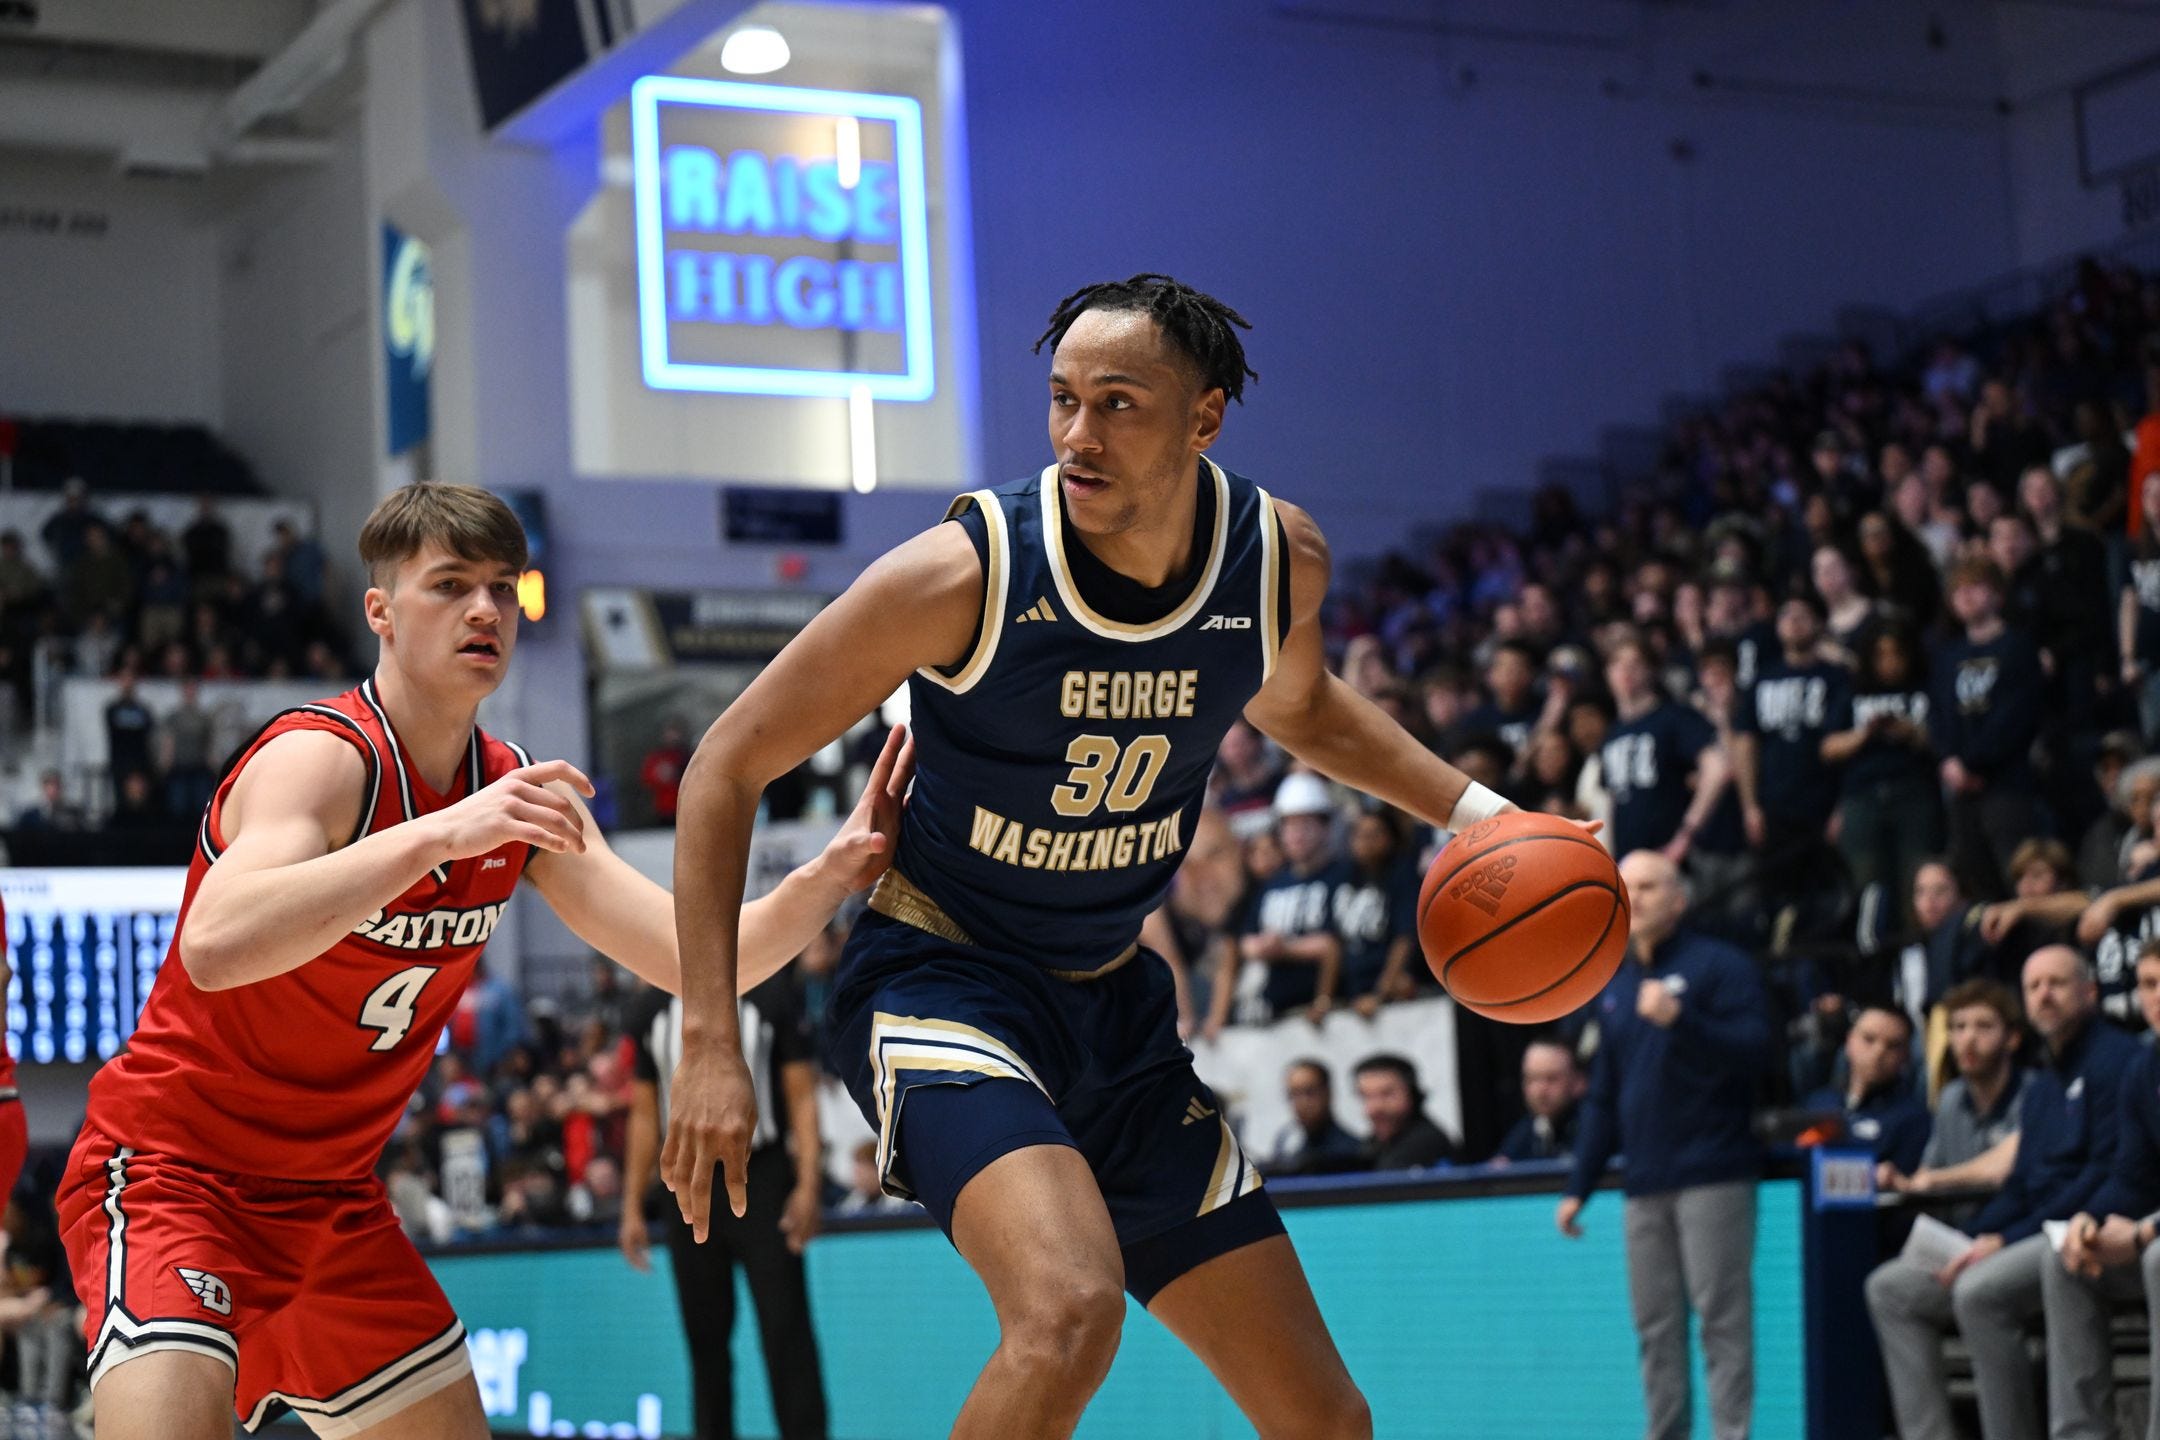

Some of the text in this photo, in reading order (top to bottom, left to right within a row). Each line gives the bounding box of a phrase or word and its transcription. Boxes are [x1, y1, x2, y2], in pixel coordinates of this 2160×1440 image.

[665, 146, 898, 242] RAISE
[670, 250, 898, 332] HIGH
[1198, 614, 1252, 631] A10
[1060, 670, 1198, 719] GEORGE
[1050, 733, 1172, 817] 30
[968, 804, 1184, 871] WASHINGTON
[1449, 854, 1518, 901] adidas
[357, 964, 441, 1053] 4
